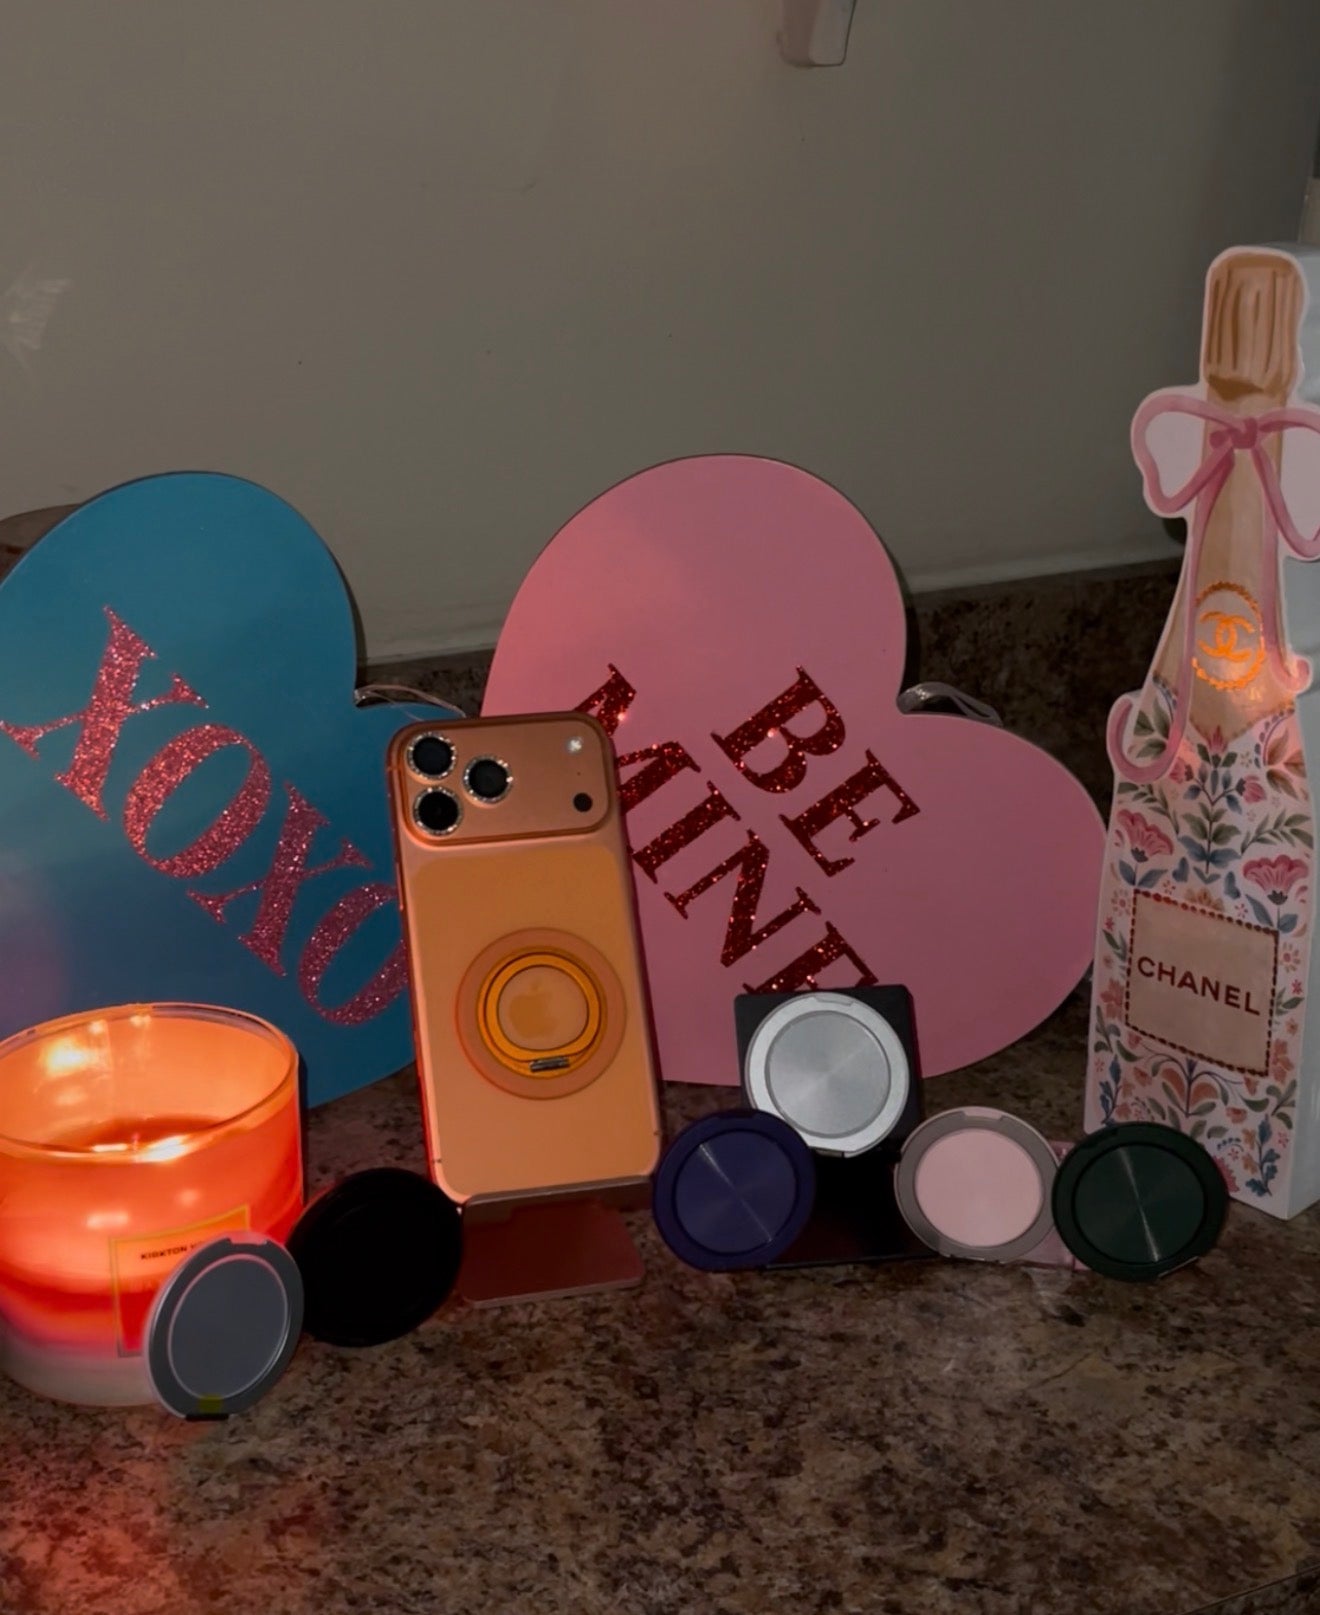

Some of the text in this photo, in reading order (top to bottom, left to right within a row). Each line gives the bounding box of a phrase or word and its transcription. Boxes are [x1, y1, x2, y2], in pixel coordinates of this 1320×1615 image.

[0, 604, 408, 1026] XOXO
[710, 665, 921, 877] BE
[1137, 956, 1260, 1016] CHANEL
